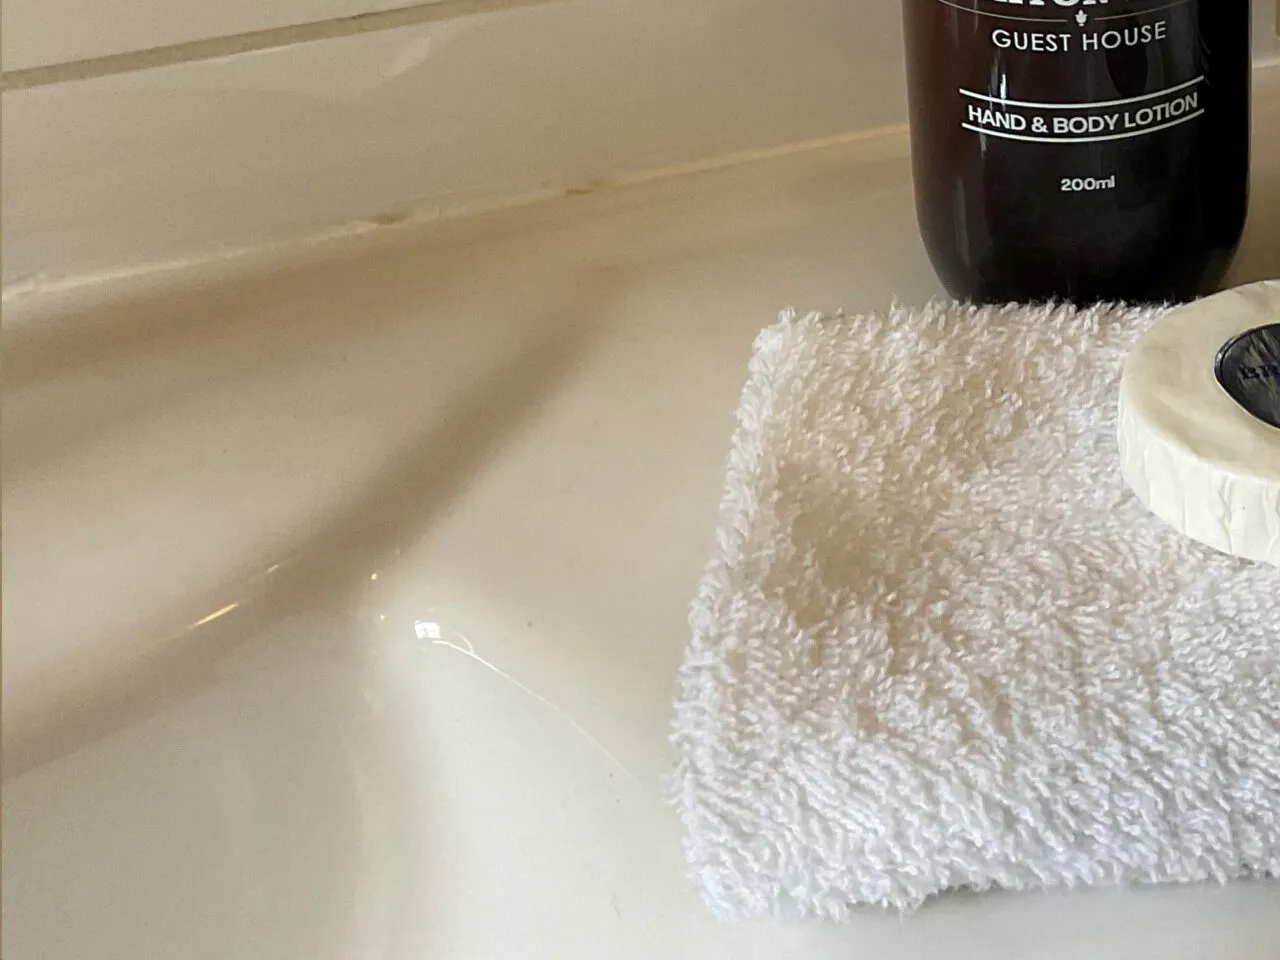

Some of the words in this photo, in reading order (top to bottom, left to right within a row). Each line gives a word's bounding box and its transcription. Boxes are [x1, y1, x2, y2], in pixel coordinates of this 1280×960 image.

[991, 28, 1072, 53] GUEST
[1082, 20, 1167, 52] HOUSE
[967, 104, 1027, 132] HAND
[1030, 116, 1049, 134] &
[1053, 113, 1120, 135] BODY
[1123, 91, 1199, 129] LOTION
[1060, 174, 1116, 192] 200ml
